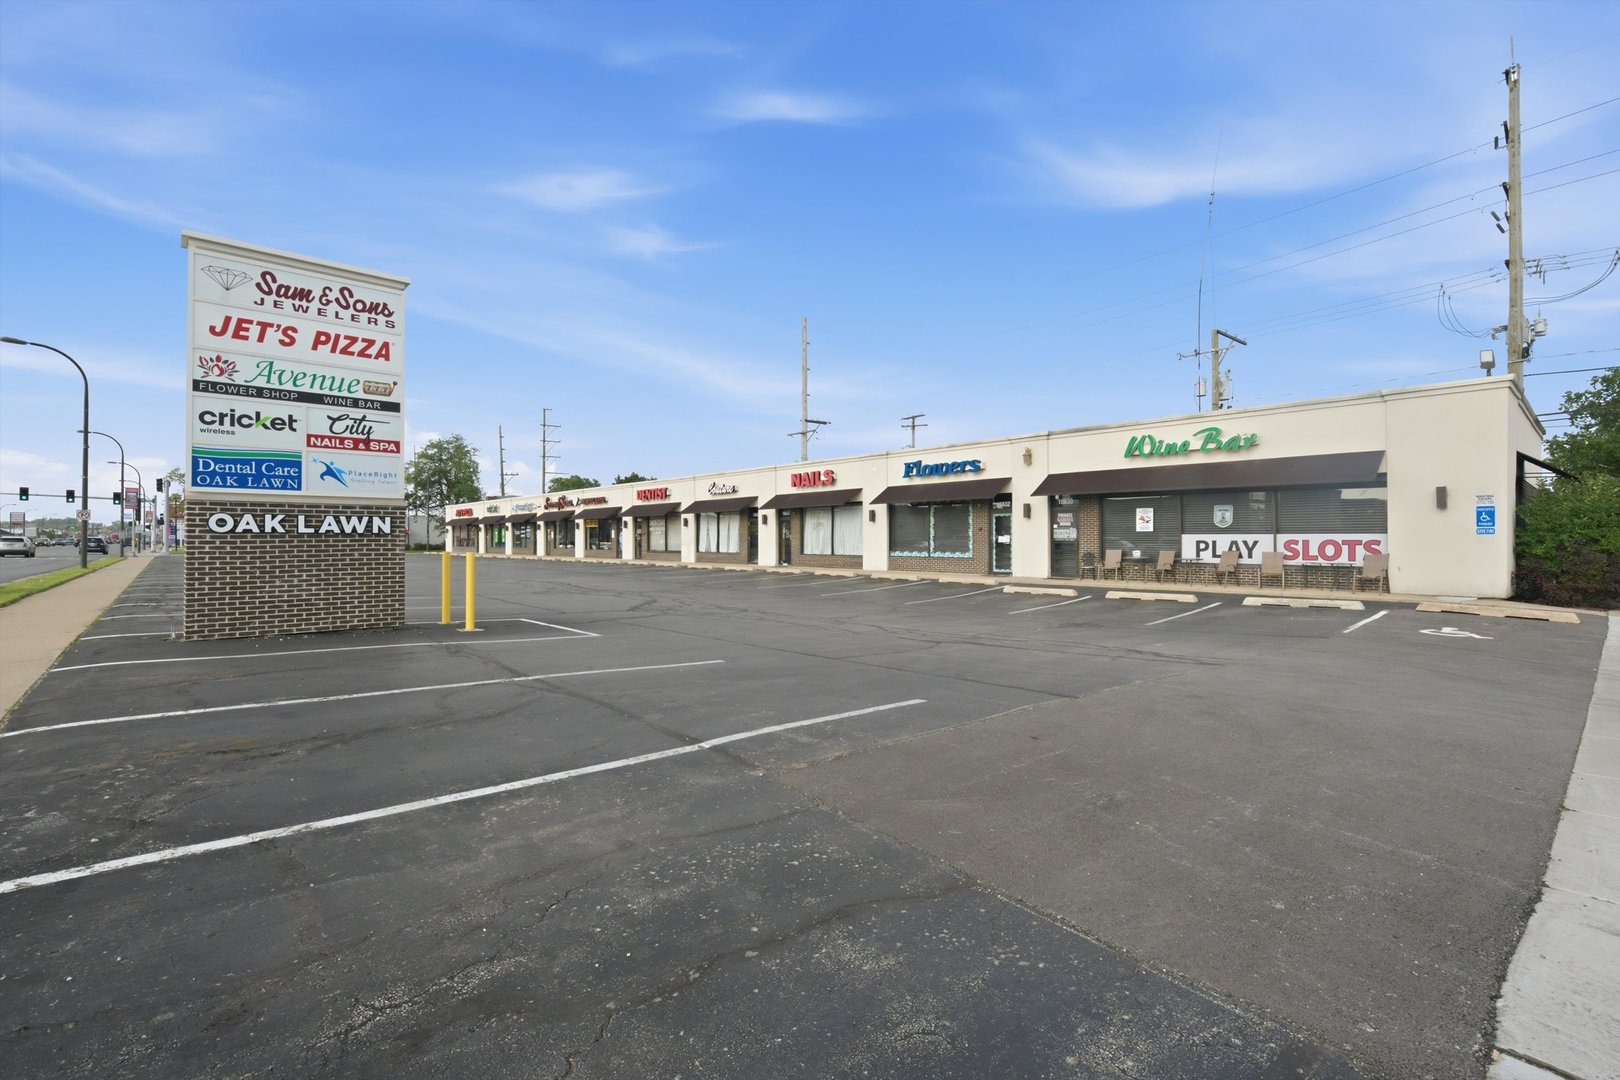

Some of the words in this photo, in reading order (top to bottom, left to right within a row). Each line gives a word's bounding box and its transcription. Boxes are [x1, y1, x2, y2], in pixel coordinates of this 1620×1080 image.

[255, 270, 315, 304] Sam
[318, 286, 334, 306] &
[334, 286, 394, 318] Sons
[254, 300, 396, 329] JEWELERS
[209, 315, 298, 347] JET'S
[311, 330, 391, 362] PIZZA
[244, 360, 360, 394] Avenue
[200, 382, 257, 398] FLOWER
[262, 389, 298, 400] SHOP
[324, 396, 354, 408] WINE
[358, 400, 381, 410] BAR
[198, 408, 298, 432] cricket
[326, 413, 391, 444] City
[200, 428, 236, 436] wireless
[1124, 434, 1190, 459] Wine
[1192, 426, 1258, 454] Bar
[310, 437, 354, 449] NAILS
[370, 442, 397, 452] SPA
[198, 458, 256, 474] Dental
[262, 462, 298, 477] Care
[348, 470, 398, 480] PlaceRight
[790, 469, 835, 488] NAILS
[903, 459, 982, 478] Flowers
[198, 474, 238, 486] OAK
[248, 478, 298, 489] LAWN
[636, 486, 668, 502] DENTIST
[208, 512, 286, 534] OAK
[298, 515, 391, 534] LAWN
[1195, 540, 1259, 560] PLAY
[1283, 538, 1382, 562] SLOTS
